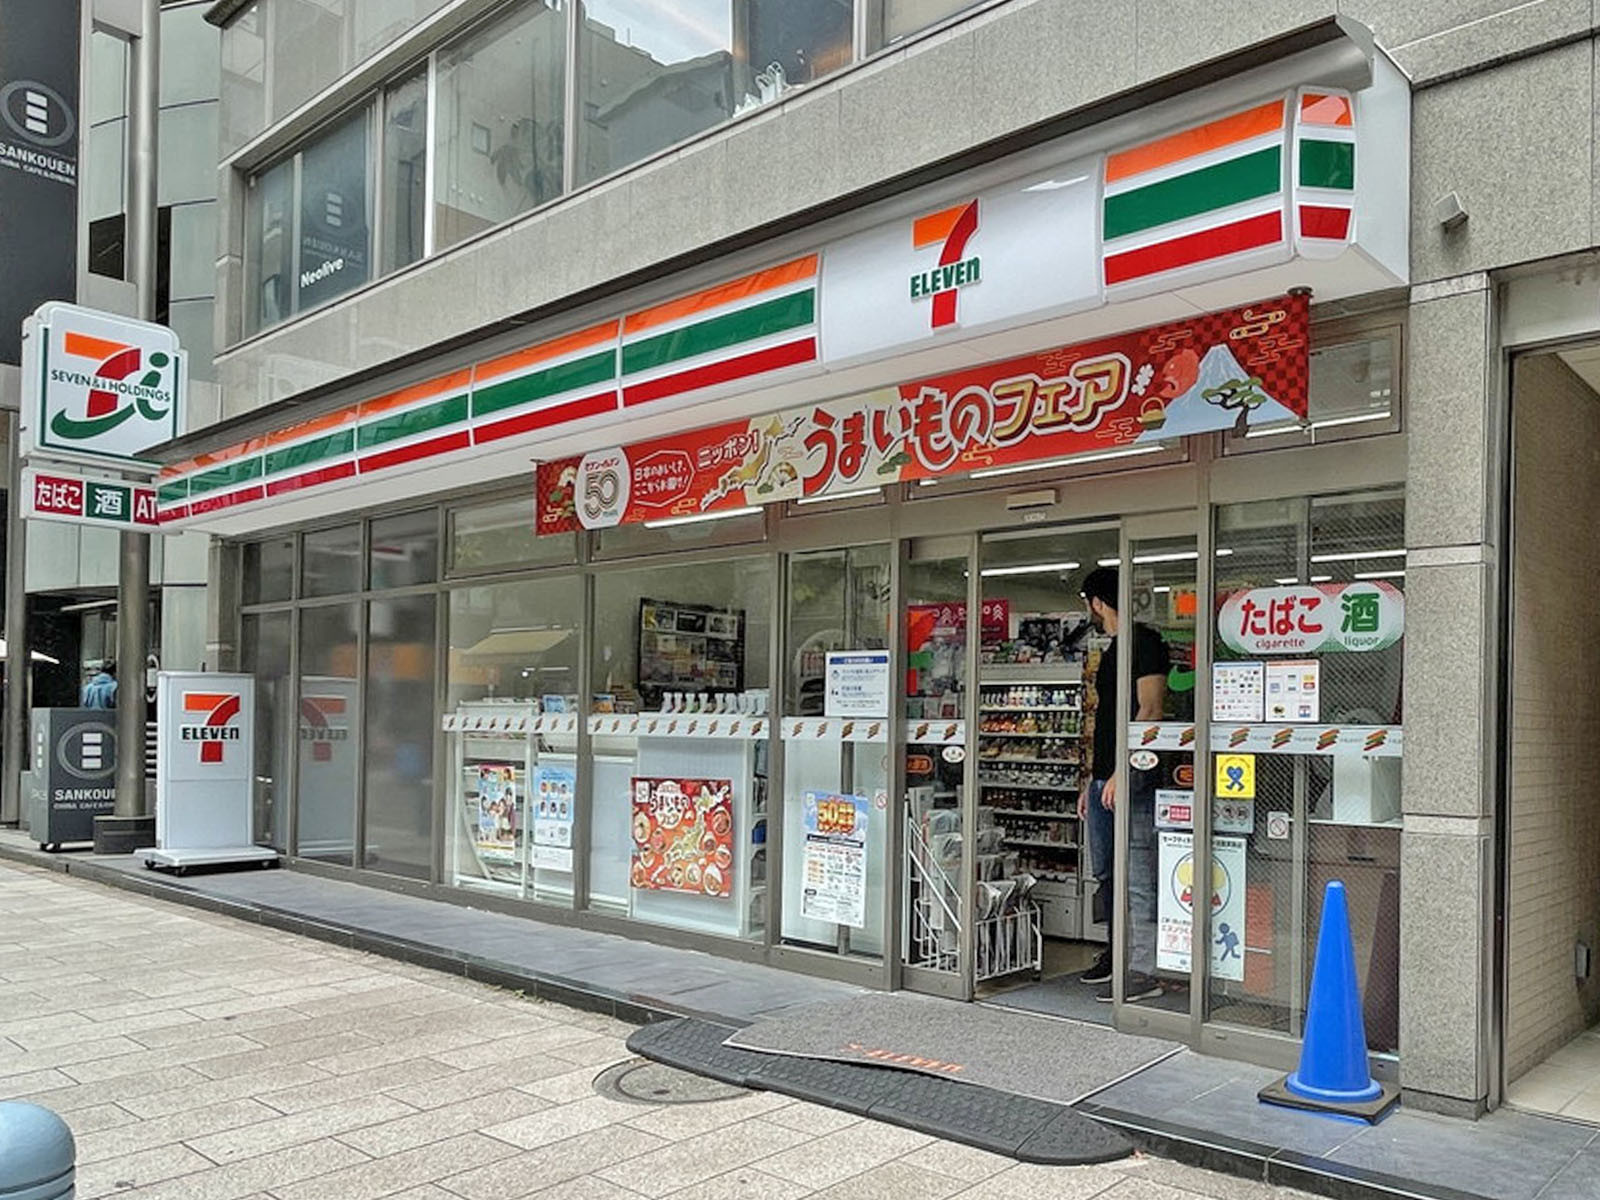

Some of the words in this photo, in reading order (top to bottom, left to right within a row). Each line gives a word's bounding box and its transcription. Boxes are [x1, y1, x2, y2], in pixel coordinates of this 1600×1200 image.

[0, 142, 76, 176] SANKOUEN
[300, 258, 344, 288] Neolive
[108, 381, 171, 402] HOLDINGS
[803, 356, 1133, 495] うまいものフェア
[37, 481, 81, 510] たばこ
[94, 488, 123, 515] 酒
[136, 495, 156, 520] AT
[584, 468, 620, 519] 50
[1241, 595, 1322, 636] たばこ
[1340, 592, 1380, 632] 酒
[1255, 638, 1305, 650] cigarette
[1344, 635, 1379, 647] liquor
[54, 788, 116, 801] SANKOU
